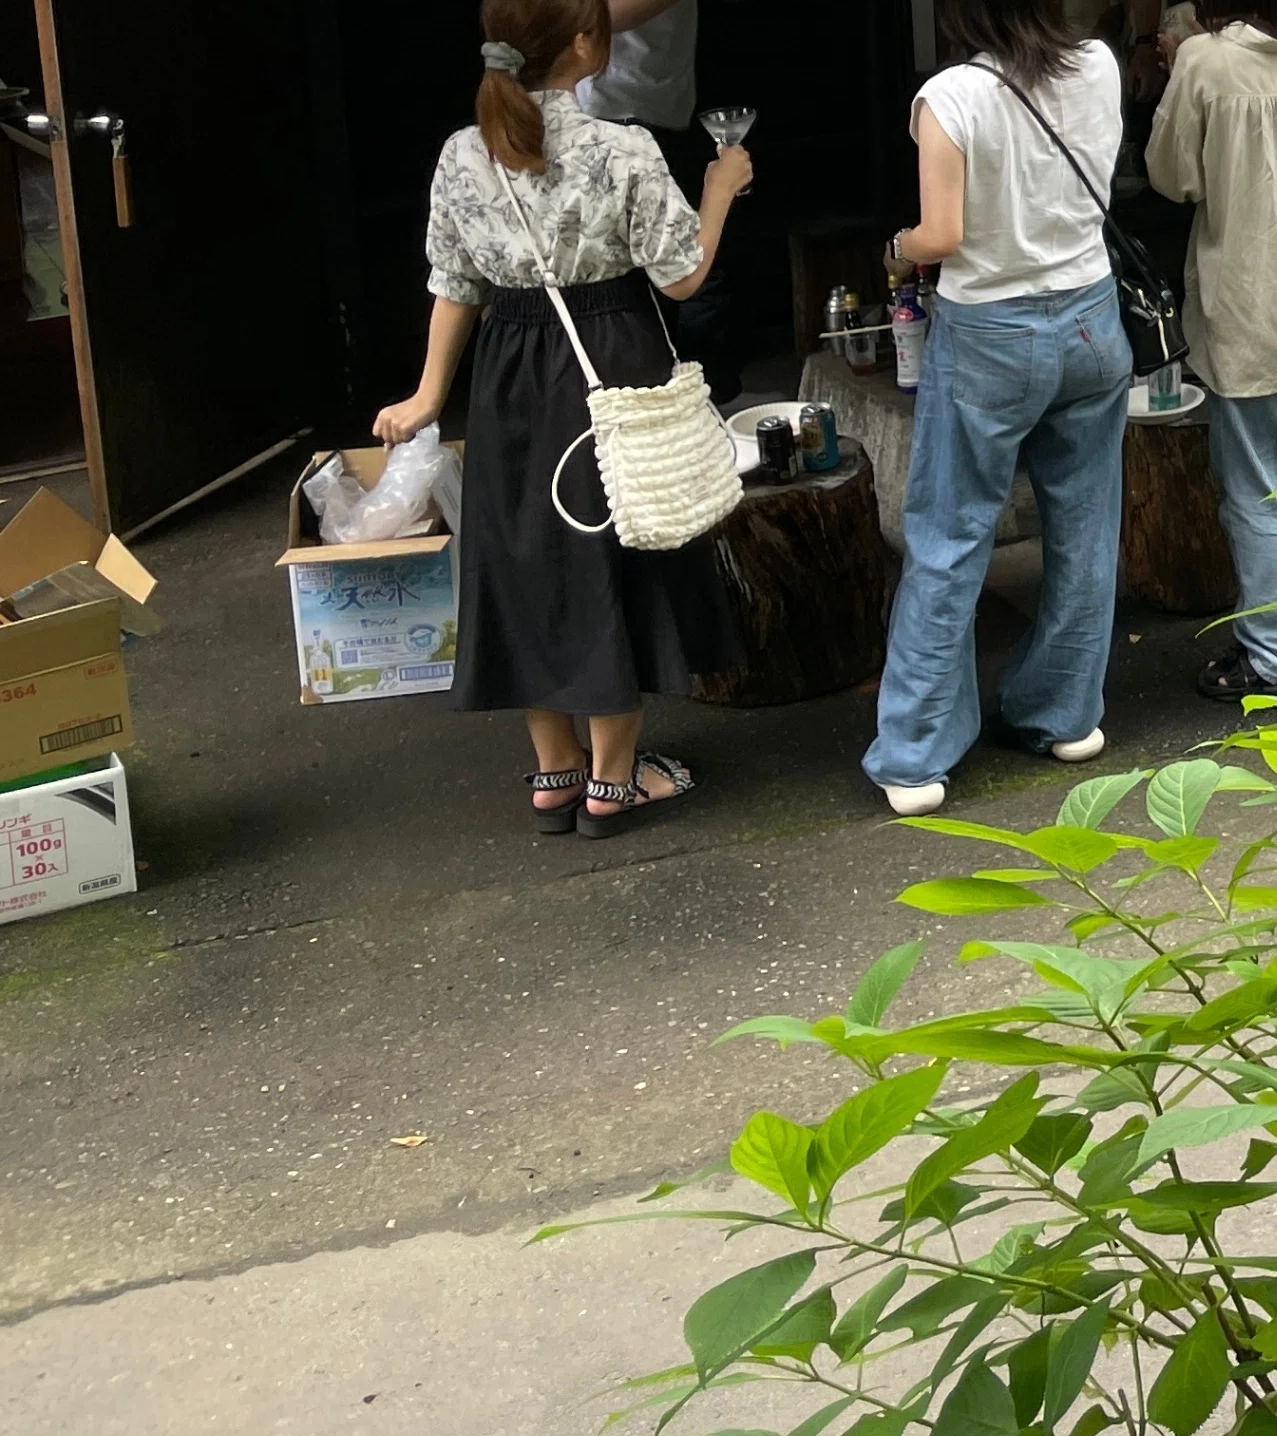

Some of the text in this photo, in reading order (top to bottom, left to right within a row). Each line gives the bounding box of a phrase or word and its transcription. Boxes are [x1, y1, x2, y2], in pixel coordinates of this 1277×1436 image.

[336, 580, 421, 611] 天然水
[16, 838, 62, 857] 100g
